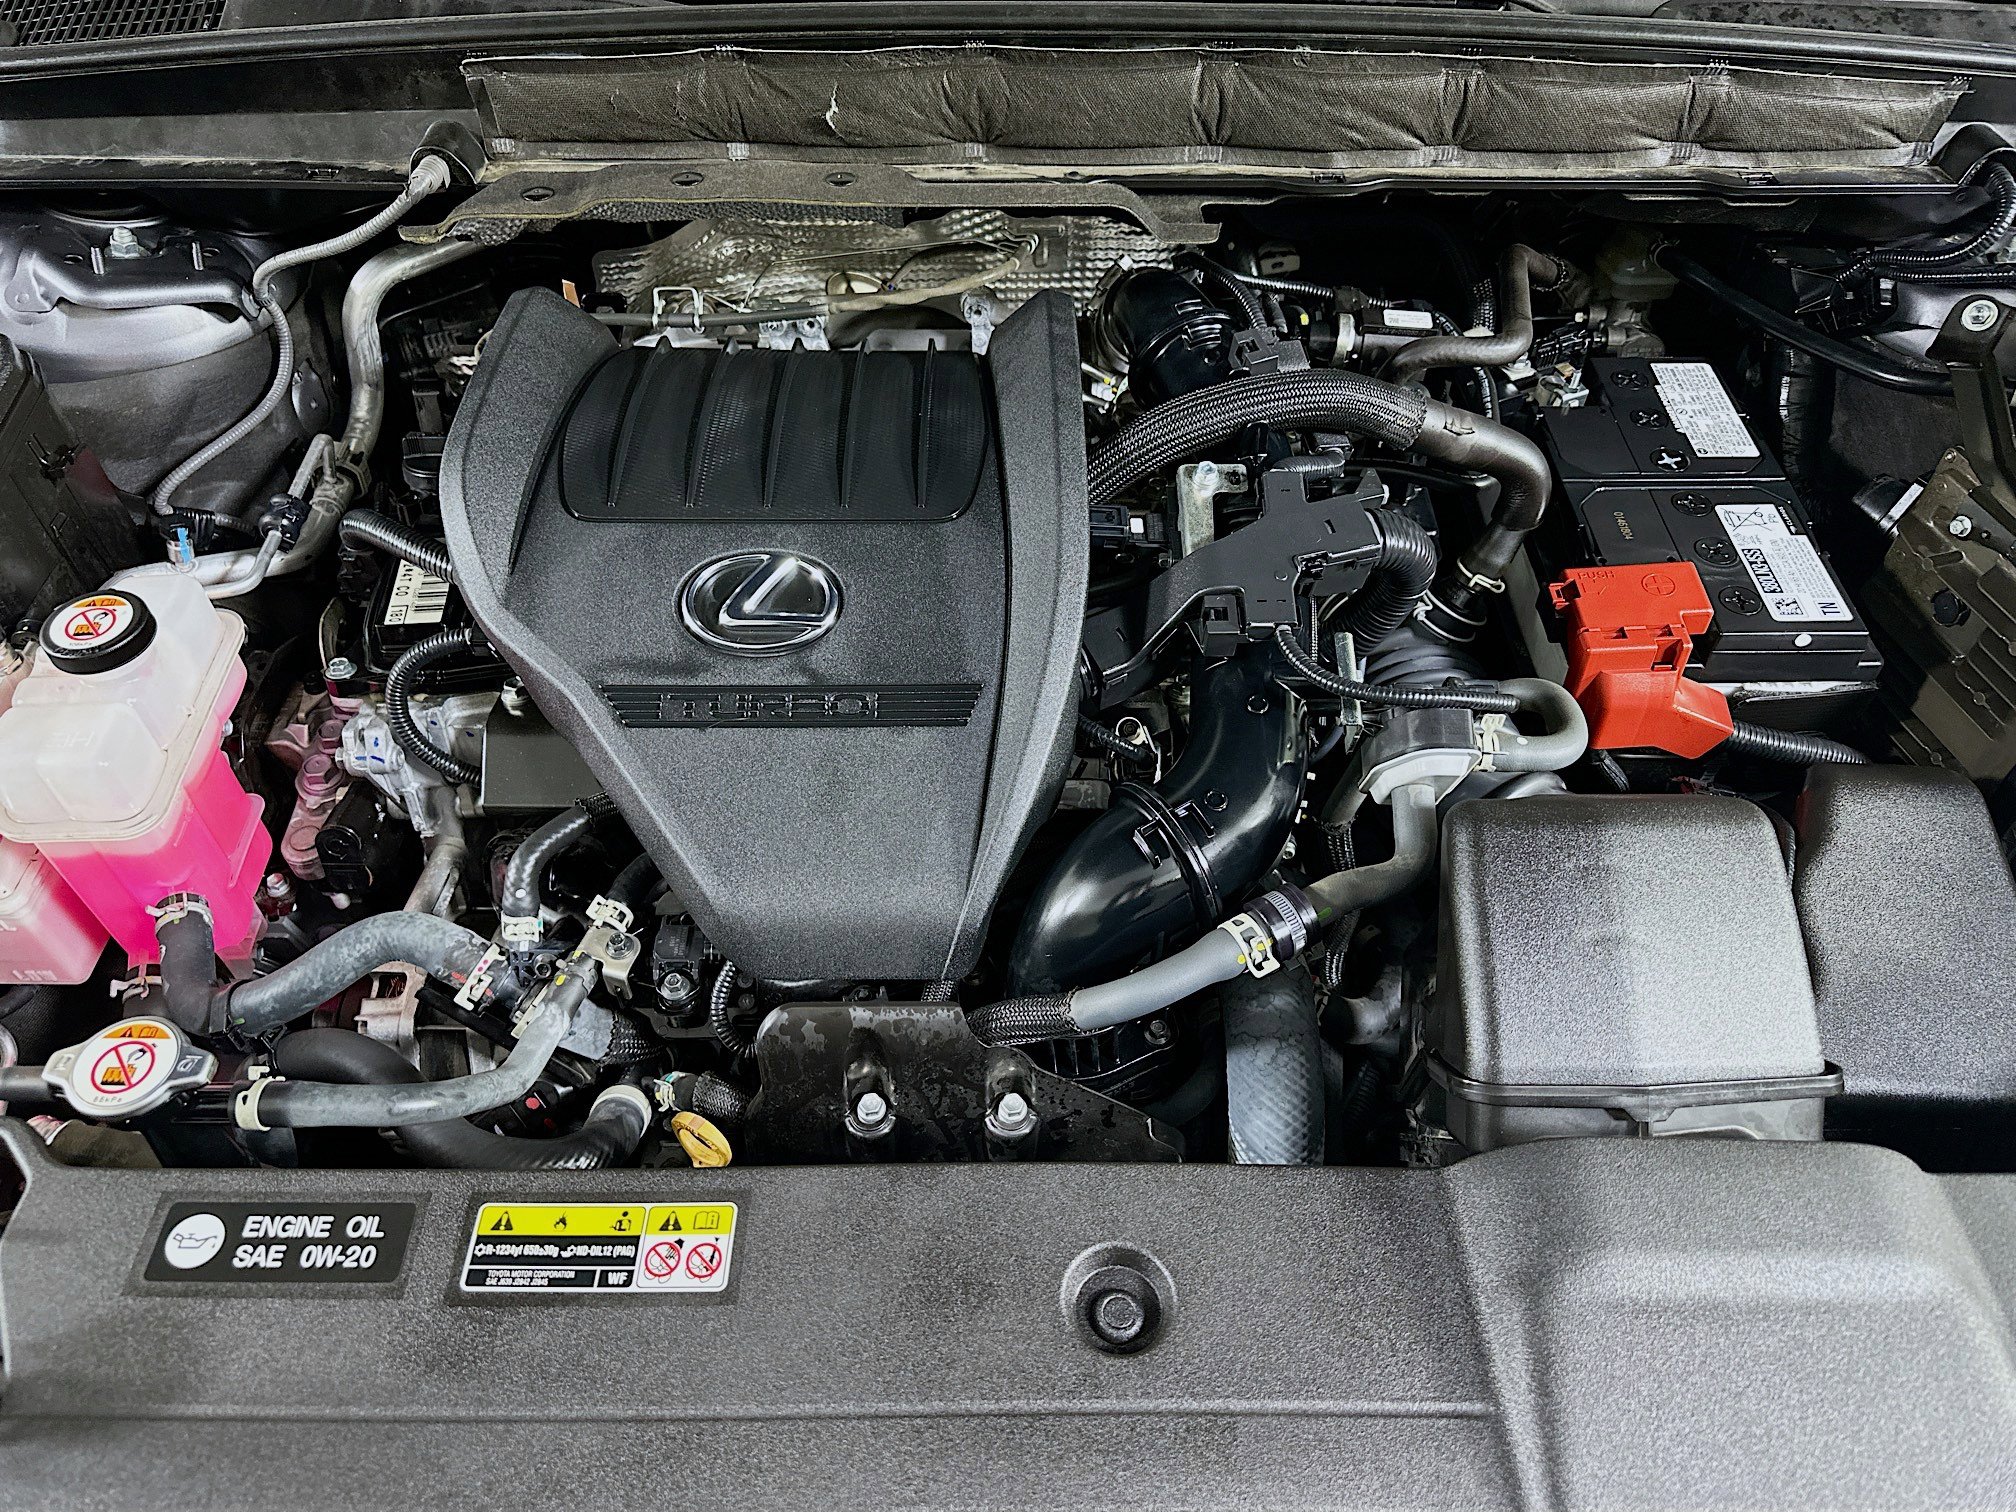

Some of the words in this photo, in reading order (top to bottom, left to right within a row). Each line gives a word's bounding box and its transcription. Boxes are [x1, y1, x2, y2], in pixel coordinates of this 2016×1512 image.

[1577, 570, 1616, 581] PUSH
[1817, 602, 1842, 616] TN
[664, 692, 873, 720] TURBO
[241, 1215, 334, 1239] ENGINE
[345, 1215, 386, 1239] OIL
[232, 1243, 287, 1269] SAE
[299, 1244, 378, 1269] 0W-20
[488, 1269, 511, 1278] TOYOTA
[511, 1269, 533, 1278] MOTOR
[533, 1270, 576, 1279] CORPORATION
[607, 1271, 629, 1285] WF
